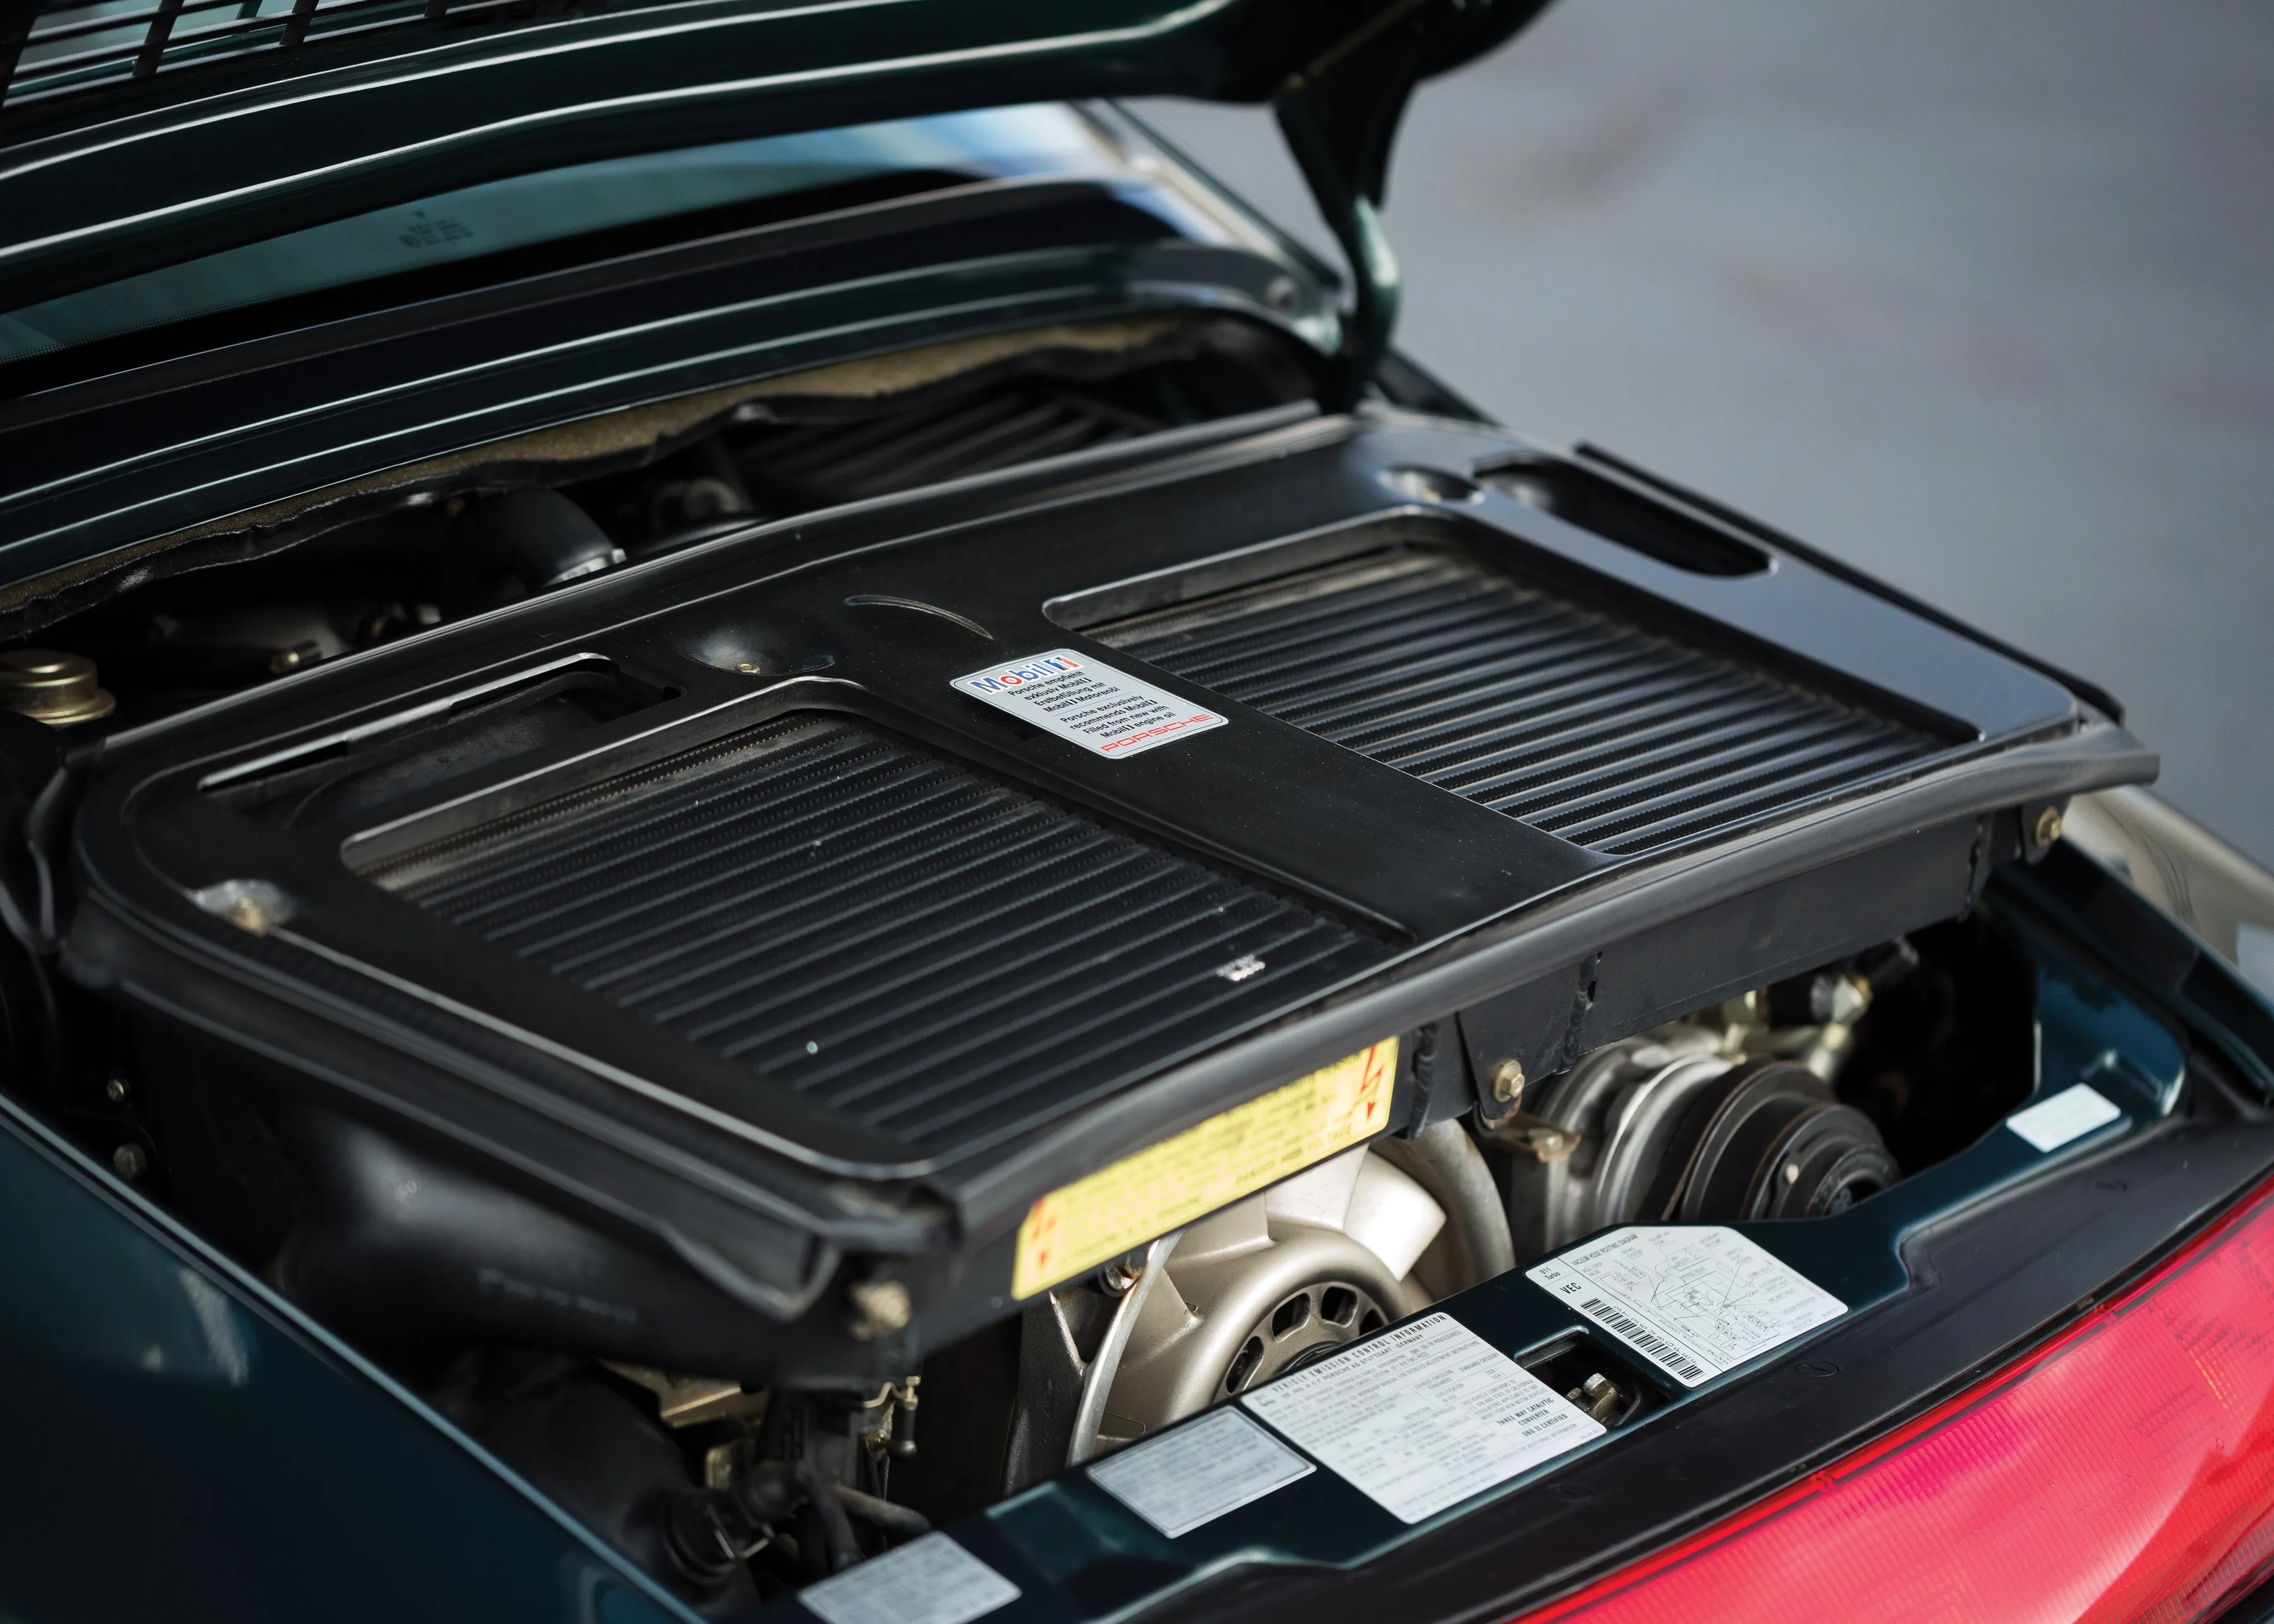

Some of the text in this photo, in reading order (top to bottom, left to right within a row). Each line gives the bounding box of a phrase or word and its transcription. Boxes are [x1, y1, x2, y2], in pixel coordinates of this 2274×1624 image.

[965, 663, 1057, 693] Mobil
[1006, 671, 1088, 695] Porsche empfiehlt
[1021, 687, 1062, 700] exklusiv
[1032, 686, 1093, 706] Erstbefüllung
[1074, 686, 1121, 702] Motorenöl
[1059, 694, 1146, 723] Porsche exclusively
[1081, 704, 1170, 733] Filled from new with
[1066, 709, 1128, 729] recommends
[1131, 715, 1167, 728] engine
[1098, 713, 1213, 752] PORSCHE
[1570, 1254, 1591, 1266] VACUUM
[1587, 1249, 1603, 1258] HOSE
[1544, 1270, 1561, 1280] Turbo
[1560, 1282, 1582, 1294] VEC
[1270, 1314, 1447, 1392] VEHICLE EMISSION CONTROL INFORMATION
[1357, 1347, 1395, 1364] STUTTGART
[1394, 1333, 1425, 1348] GERMANY
[1423, 1352, 1453, 1366] ADJUSTMENT
[1448, 1340, 1481, 1355] INSTRUCTIONS
[1706, 1349, 1730, 1364] VENTING
[1457, 1351, 1501, 1372] STANDARD CATEGORY
[1485, 1381, 1512, 1394] CONFORMS
[1492, 1391, 1507, 1399] STATE
[1508, 1378, 1534, 1391] CALIFORNIA
[1499, 1390, 1525, 1403] APPLICABLE
[1526, 1387, 1548, 1398] VEHICLES
[1496, 1397, 1555, 1426] THREE WAY CATALYTIC
[1516, 1408, 1551, 1426] CONVERTER
[1521, 1428, 1536, 1437] OBD
[1539, 1412, 1569, 1428] CERTIFIED
